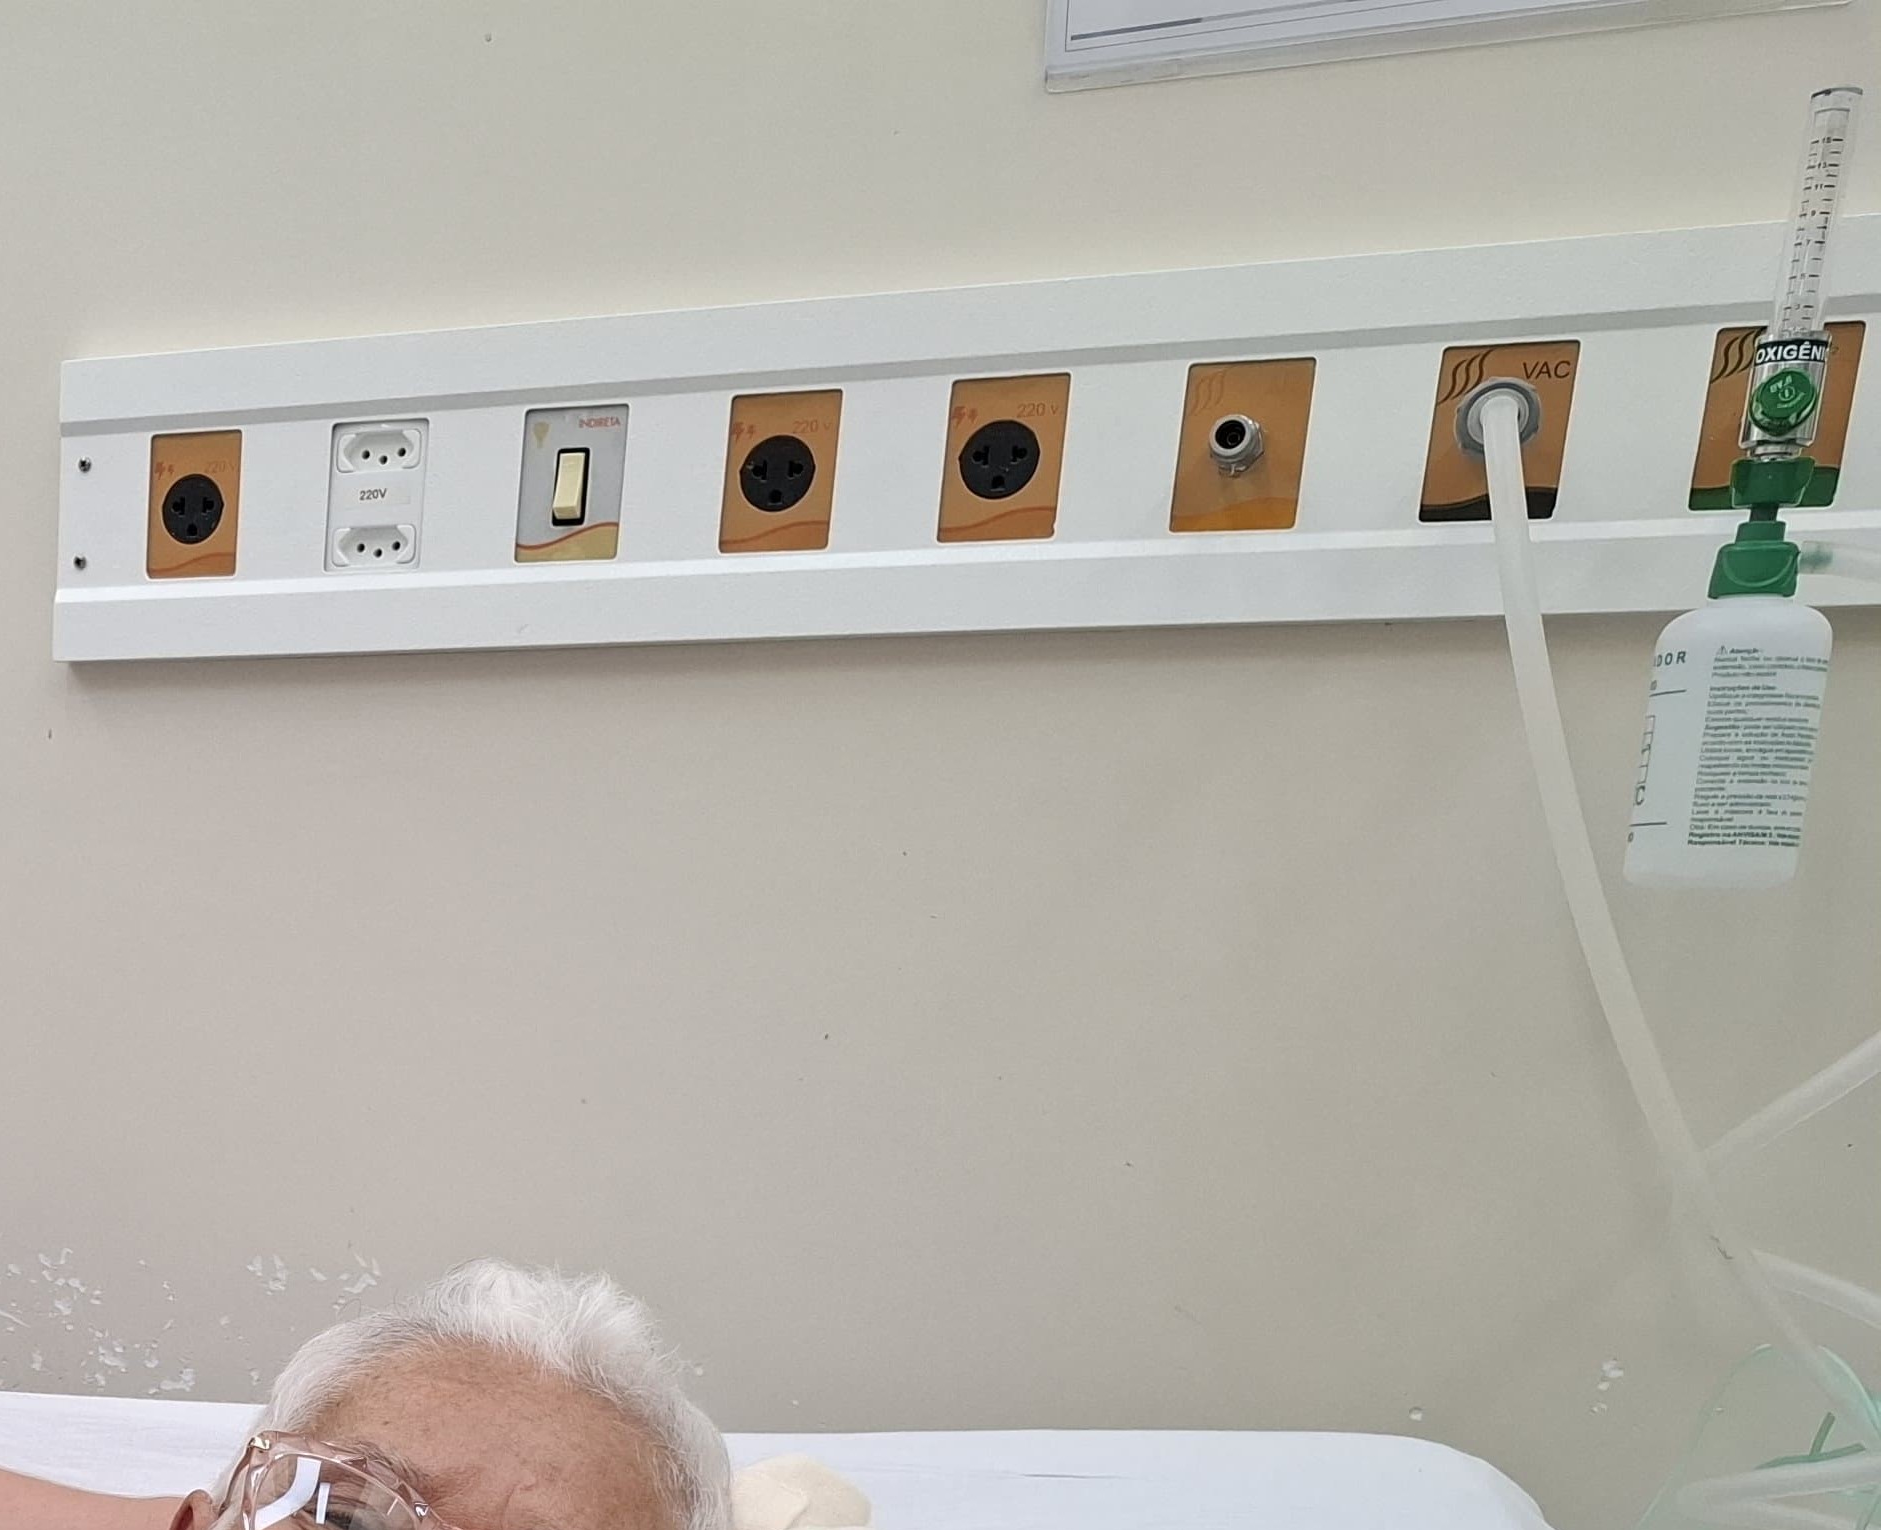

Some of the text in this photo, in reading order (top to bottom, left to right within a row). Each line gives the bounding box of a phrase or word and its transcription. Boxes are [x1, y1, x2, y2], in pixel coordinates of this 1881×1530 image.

[1755, 341, 1828, 364] OXIGÊNI
[1522, 360, 1572, 380] VAC
[1017, 402, 1046, 419] 220
[578, 416, 622, 430] INDIRETA
[792, 419, 819, 434] 220
[359, 487, 388, 501] 220V
[1653, 651, 1687, 668] DOR
